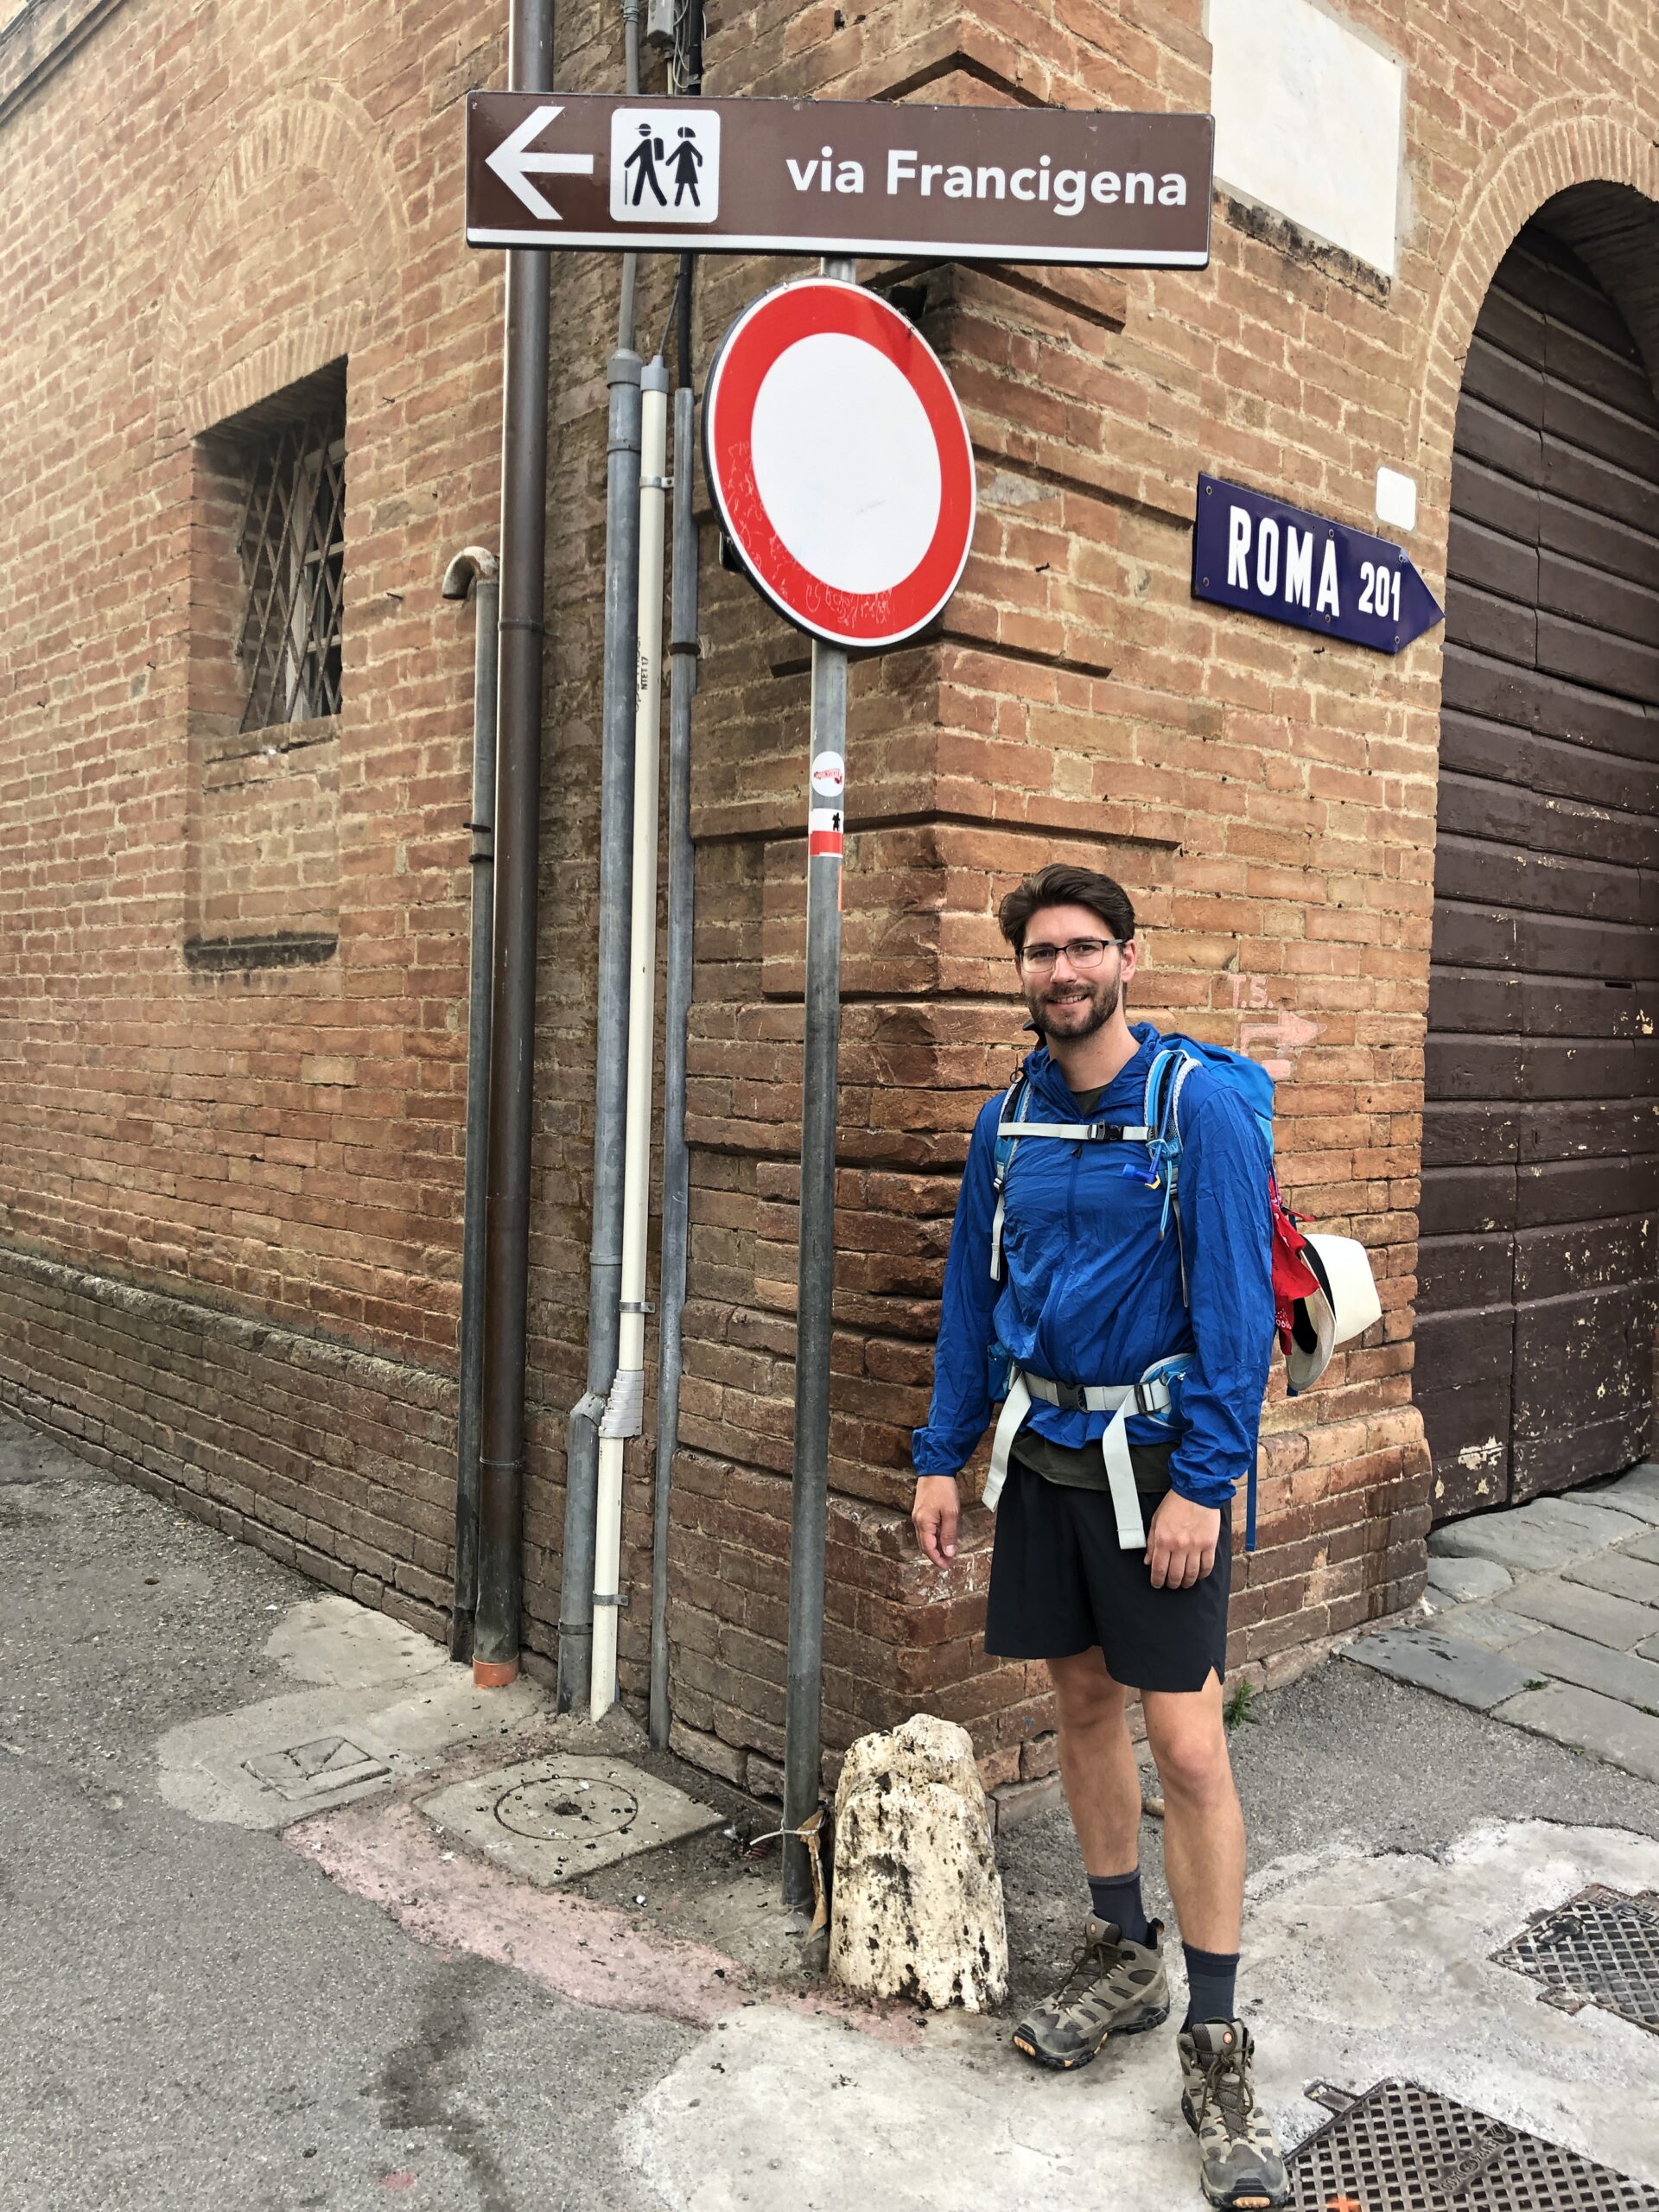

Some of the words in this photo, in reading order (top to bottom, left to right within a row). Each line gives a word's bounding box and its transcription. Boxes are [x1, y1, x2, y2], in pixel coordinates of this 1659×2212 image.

[786, 146, 863, 193] via
[887, 149, 1186, 216] Francigena
[1227, 505, 1339, 617] ROMA
[1357, 562, 1402, 621] 201
